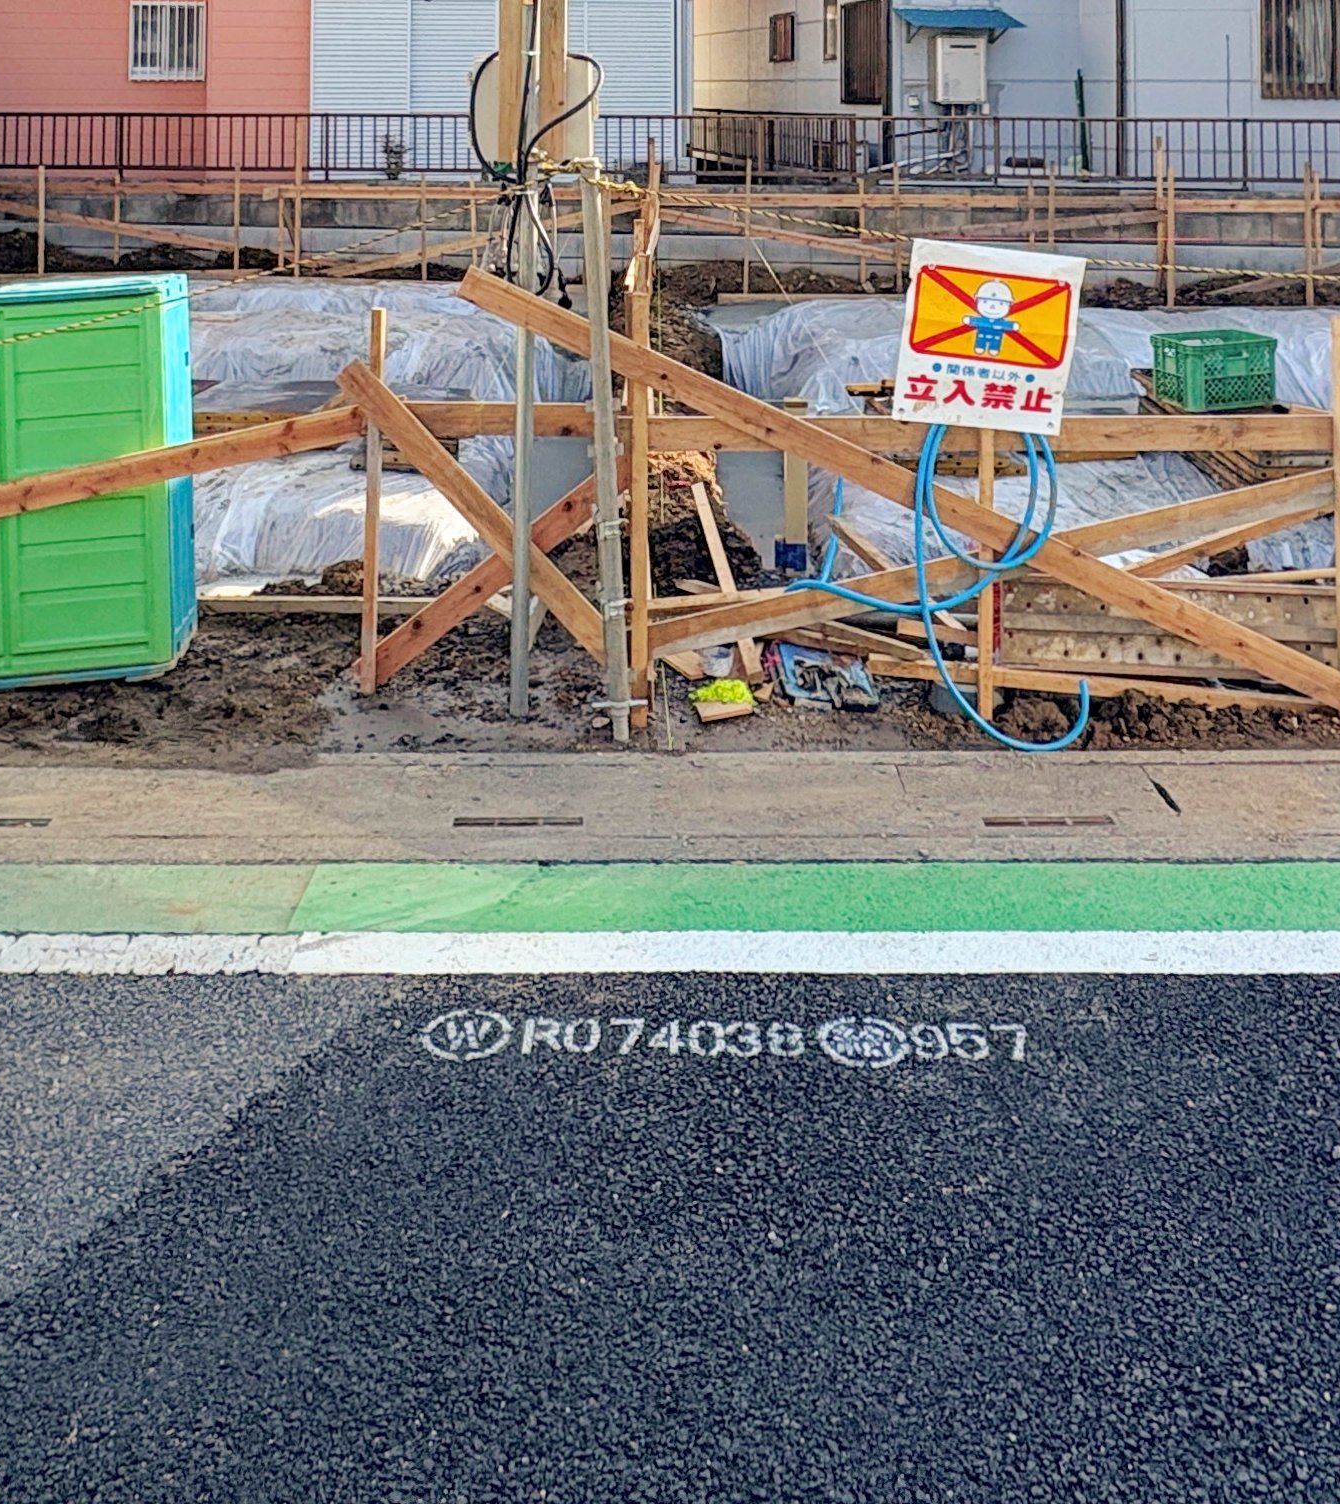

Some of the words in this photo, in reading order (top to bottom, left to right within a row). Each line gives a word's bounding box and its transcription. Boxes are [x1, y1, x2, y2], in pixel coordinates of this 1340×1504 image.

[946, 363, 1021, 382] 関係者以外
[904, 374, 1053, 414] 立入禁止
[911, 1022, 1028, 1061] 957
